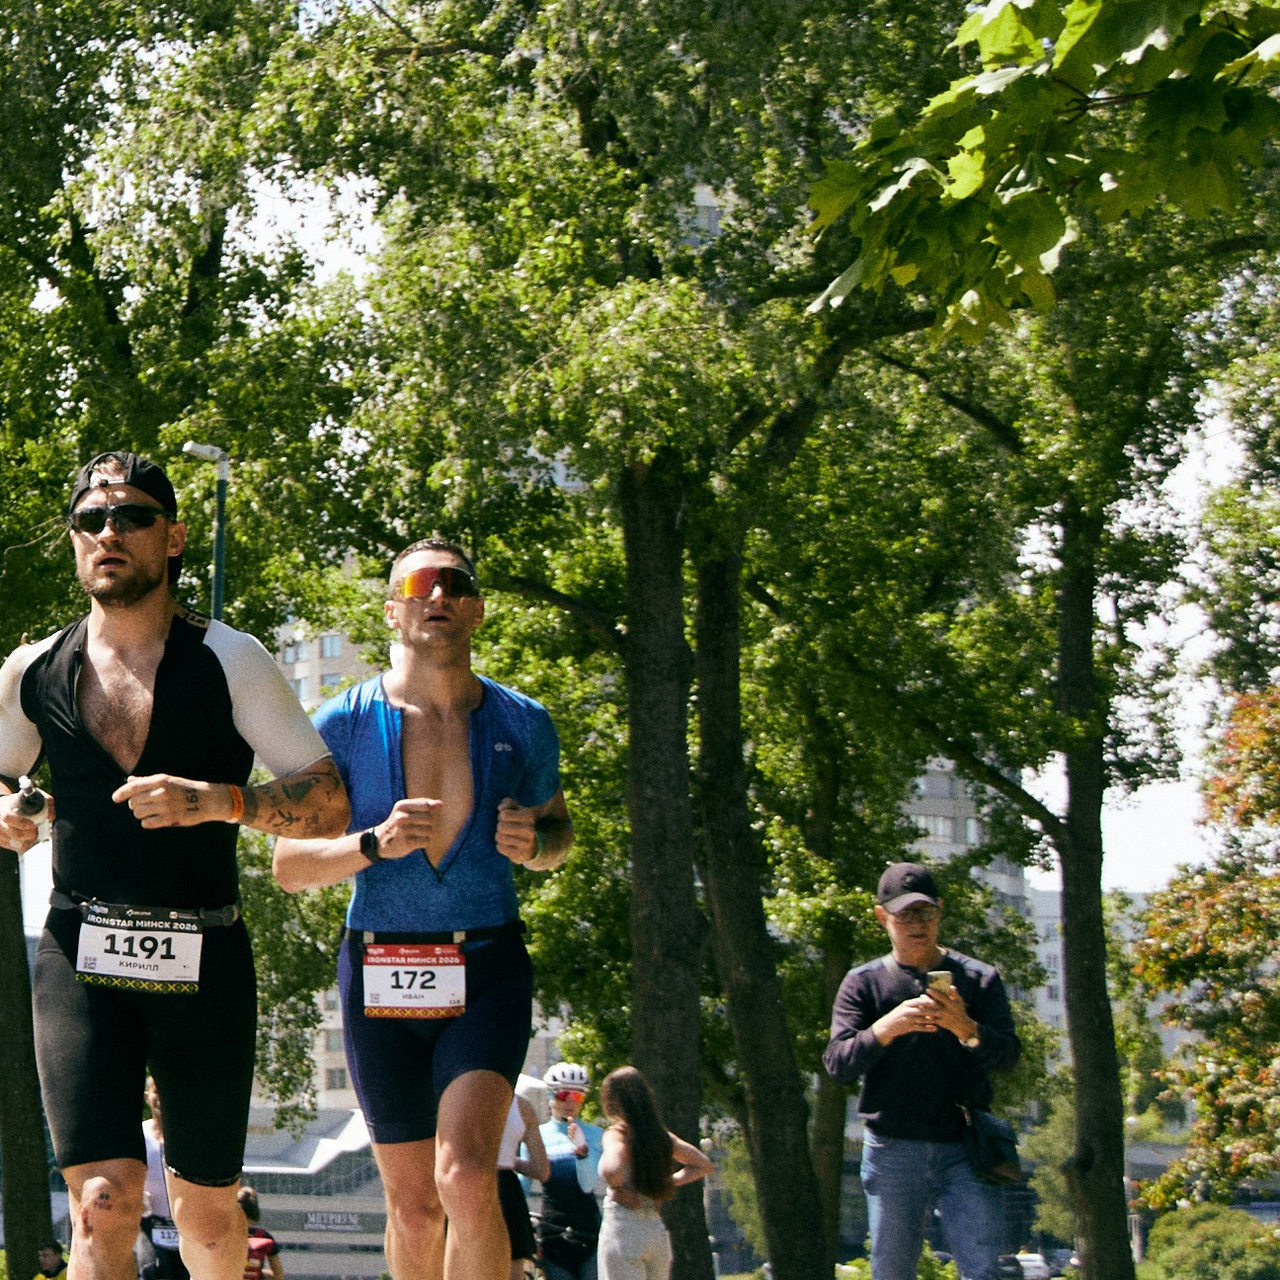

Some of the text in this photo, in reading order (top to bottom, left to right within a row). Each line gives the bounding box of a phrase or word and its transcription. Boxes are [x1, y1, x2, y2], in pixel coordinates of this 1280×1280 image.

[87, 914, 198, 931] IRONSTAR МИНСК 2026
[103, 933, 176, 960] 1191
[118, 960, 159, 972] КИРИЛЛ
[367, 956, 460, 964] IRONSTAR МИНСК 2026
[390, 970, 437, 990] 172
